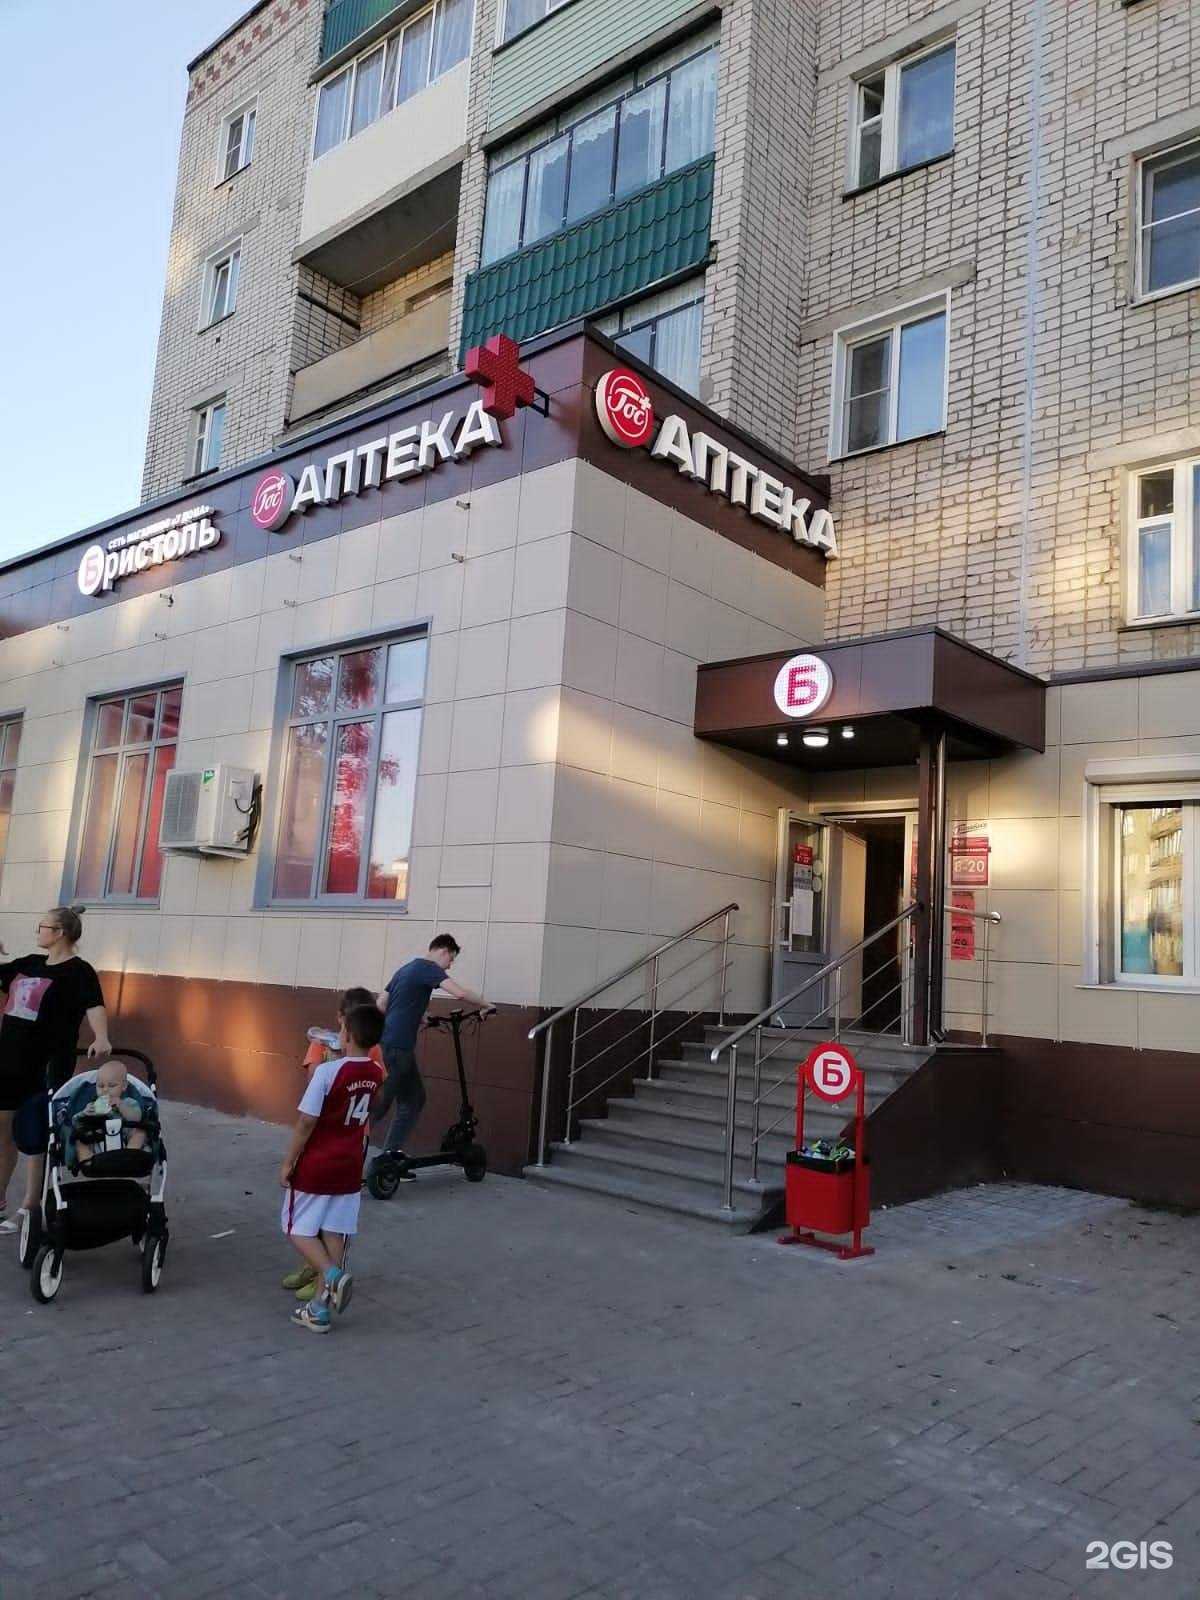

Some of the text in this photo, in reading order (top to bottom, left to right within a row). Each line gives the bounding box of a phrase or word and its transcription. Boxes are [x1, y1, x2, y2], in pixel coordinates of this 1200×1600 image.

[289, 399, 502, 513] АПТЕКА
[651, 414, 838, 559] АПТЕКА
[787, 665, 818, 706] Б
[822, 1058, 844, 1087] Б
[344, 1093, 370, 1126] 14
